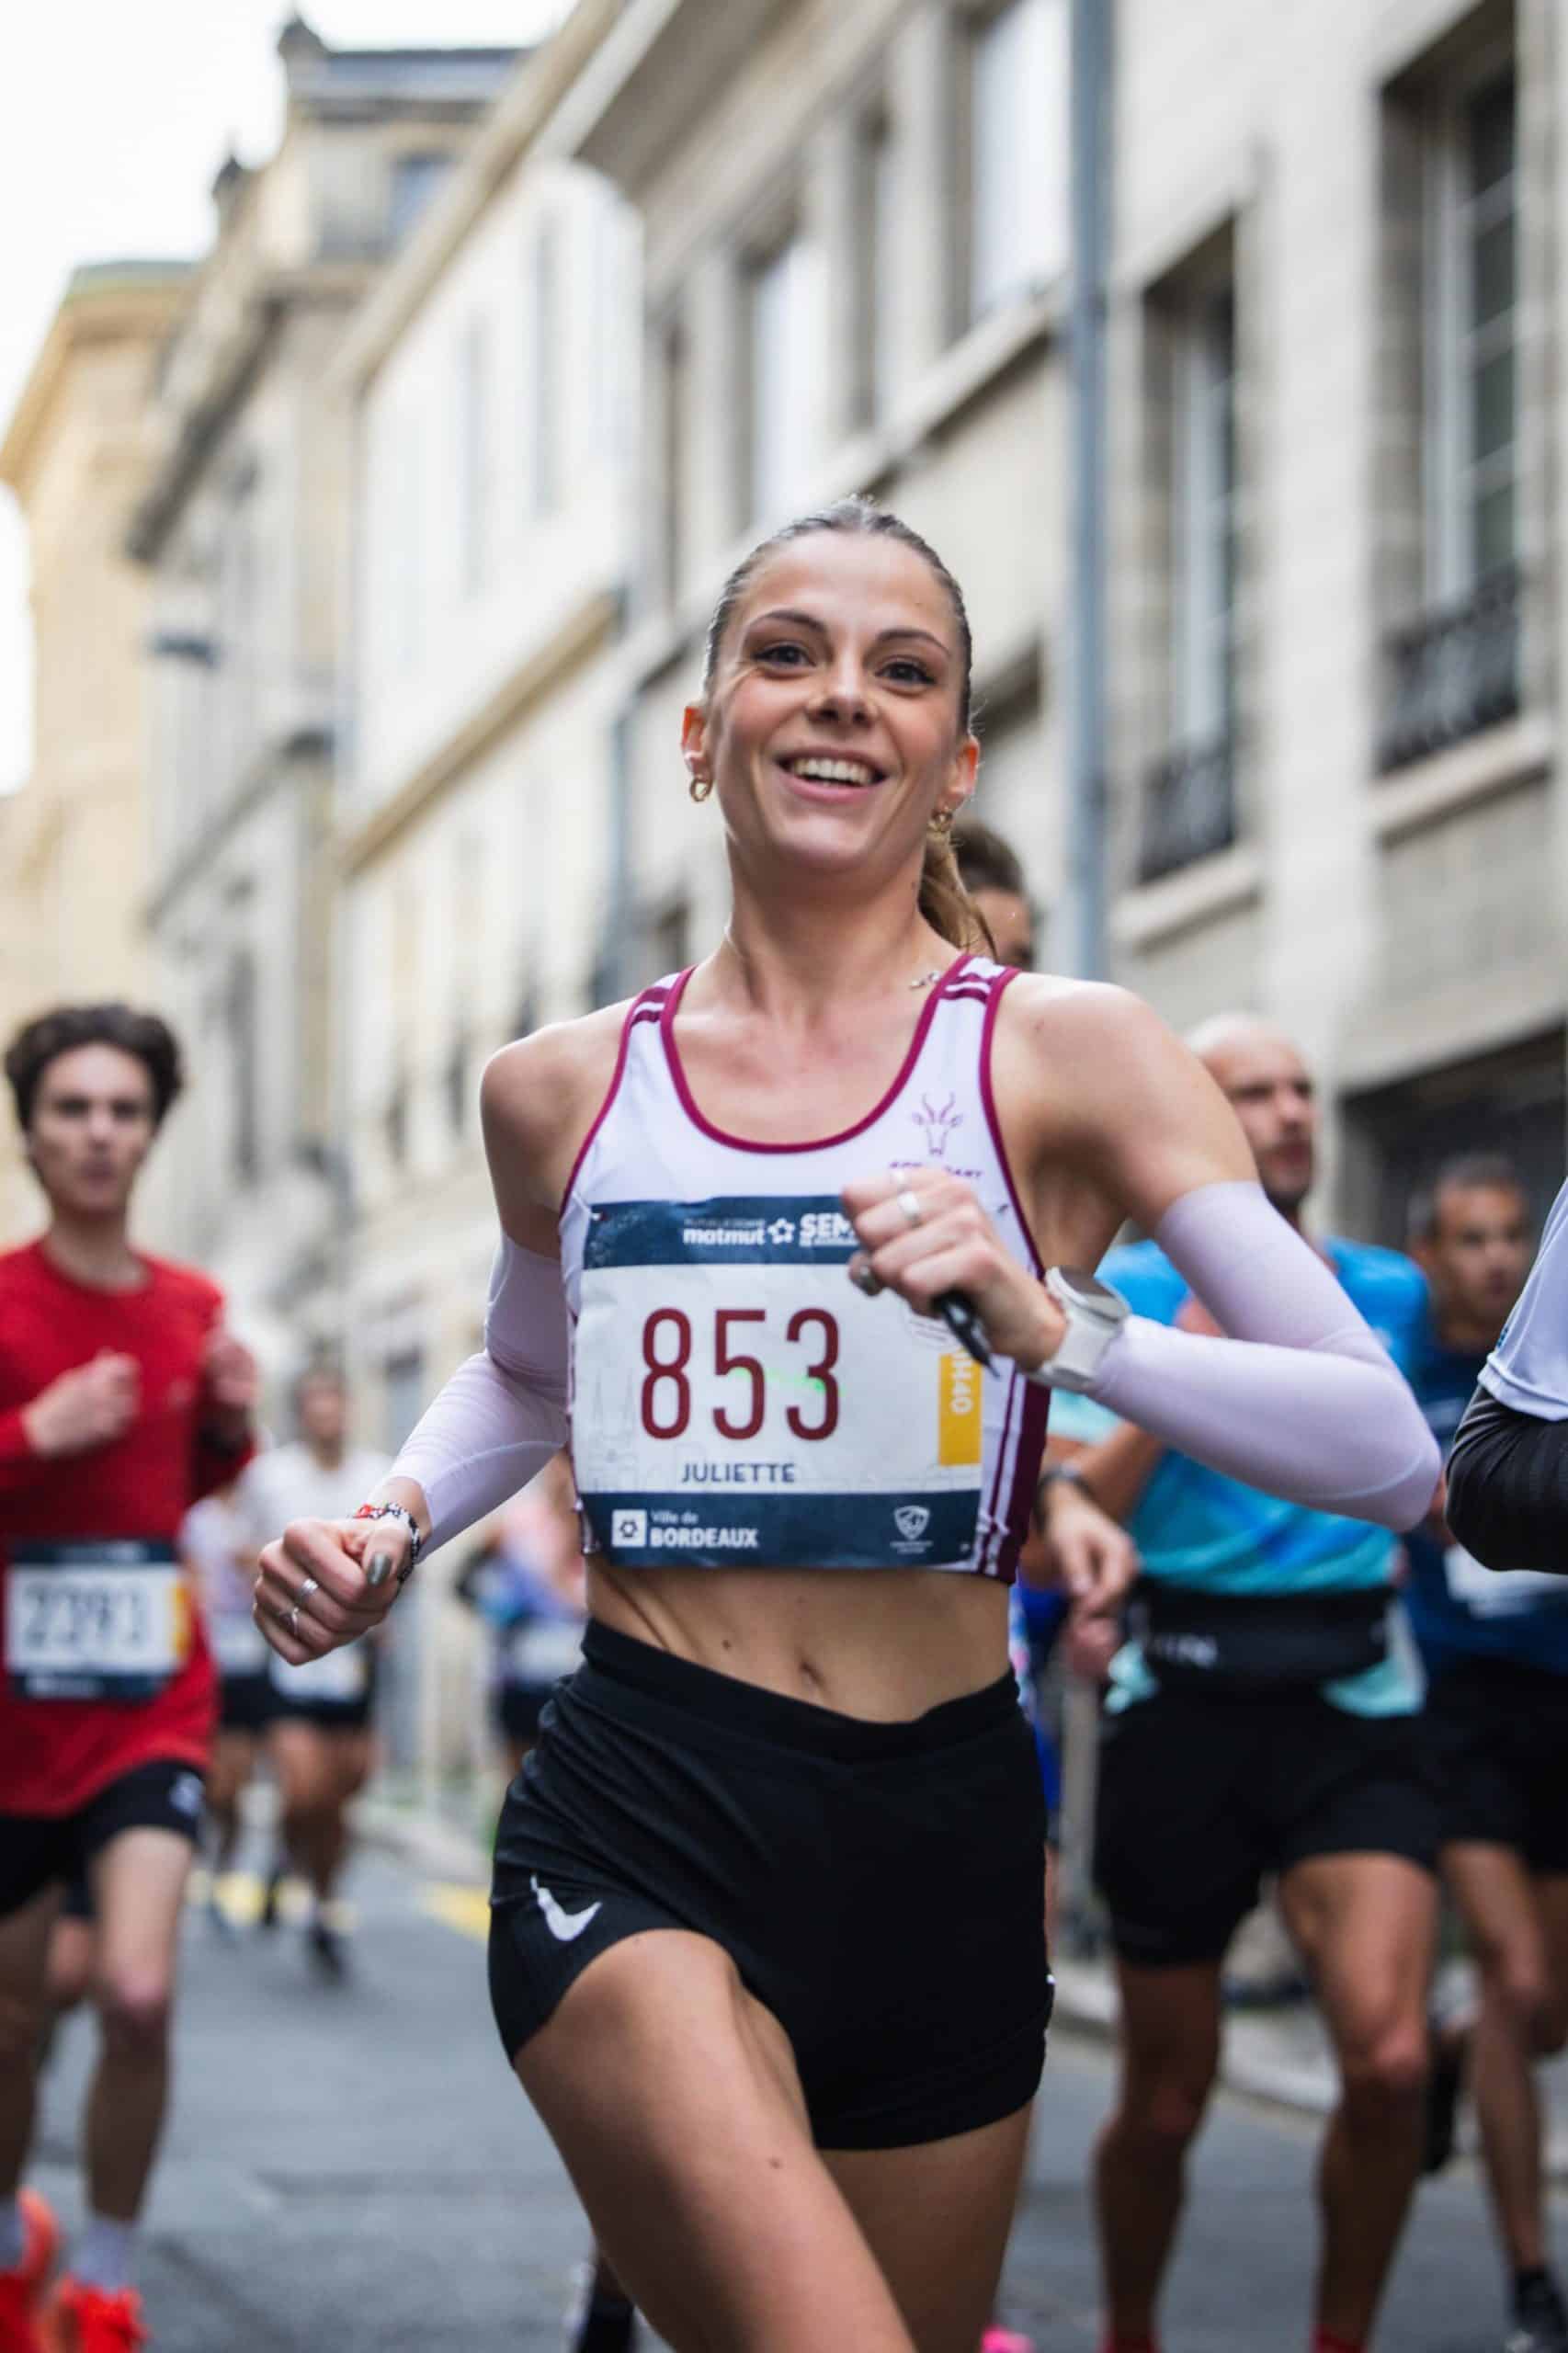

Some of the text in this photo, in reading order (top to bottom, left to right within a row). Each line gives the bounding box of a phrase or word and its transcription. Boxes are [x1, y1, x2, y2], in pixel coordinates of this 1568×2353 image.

[800, 1212, 856, 1236] SEM
[683, 1228, 765, 1245] matmut
[642, 1308, 839, 1440] 853
[681, 1462, 796, 1483] JULIETTE
[651, 1510, 699, 1524] Ville de
[650, 1527, 759, 1548] BORDEAUX
